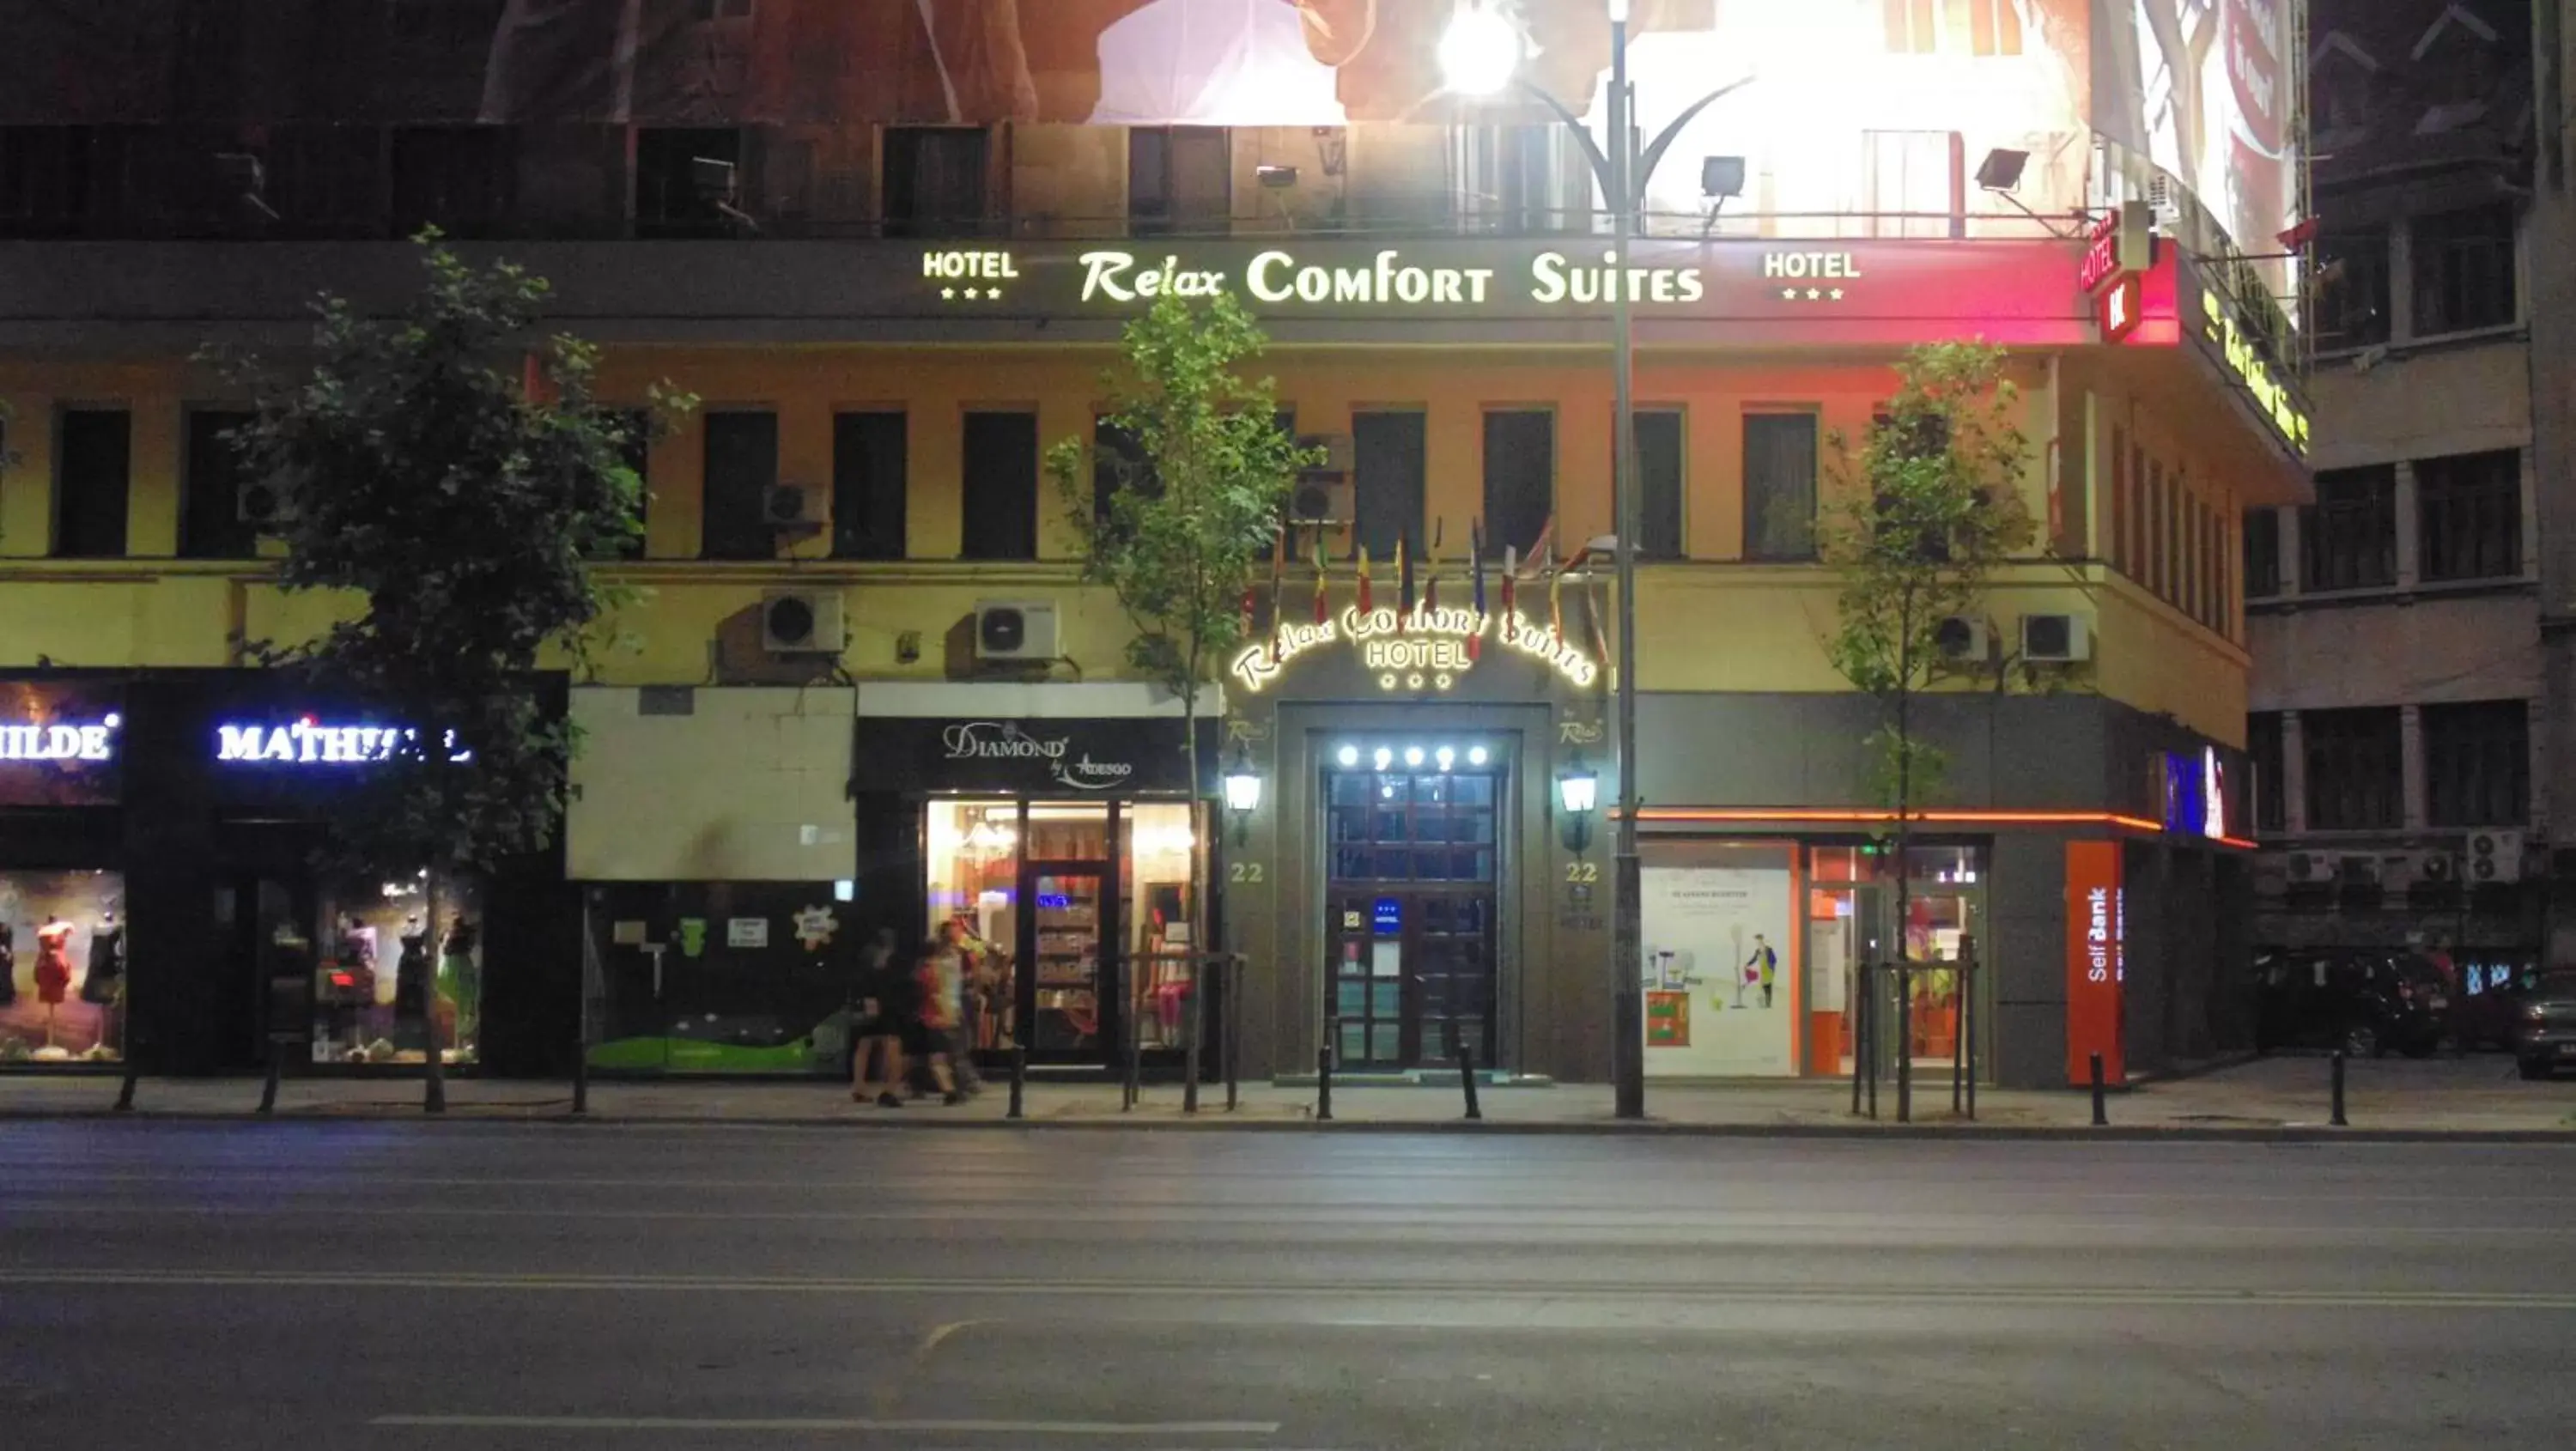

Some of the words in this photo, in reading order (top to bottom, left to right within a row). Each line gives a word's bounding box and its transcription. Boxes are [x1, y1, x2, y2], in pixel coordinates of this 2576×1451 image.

[923, 251, 1019, 277] HOTEL
[1078, 252, 1226, 302] Relax
[1765, 252, 1862, 278] HOTEL
[1366, 639, 1473, 670] HOTEL
[0, 726, 111, 760] ILDE
[943, 722, 1068, 758] DIAMOND
[1230, 862, 1263, 883] 22
[1565, 862, 1598, 883] 22
[2087, 887, 2106, 941] Bank
[2087, 944, 2107, 982] Self
